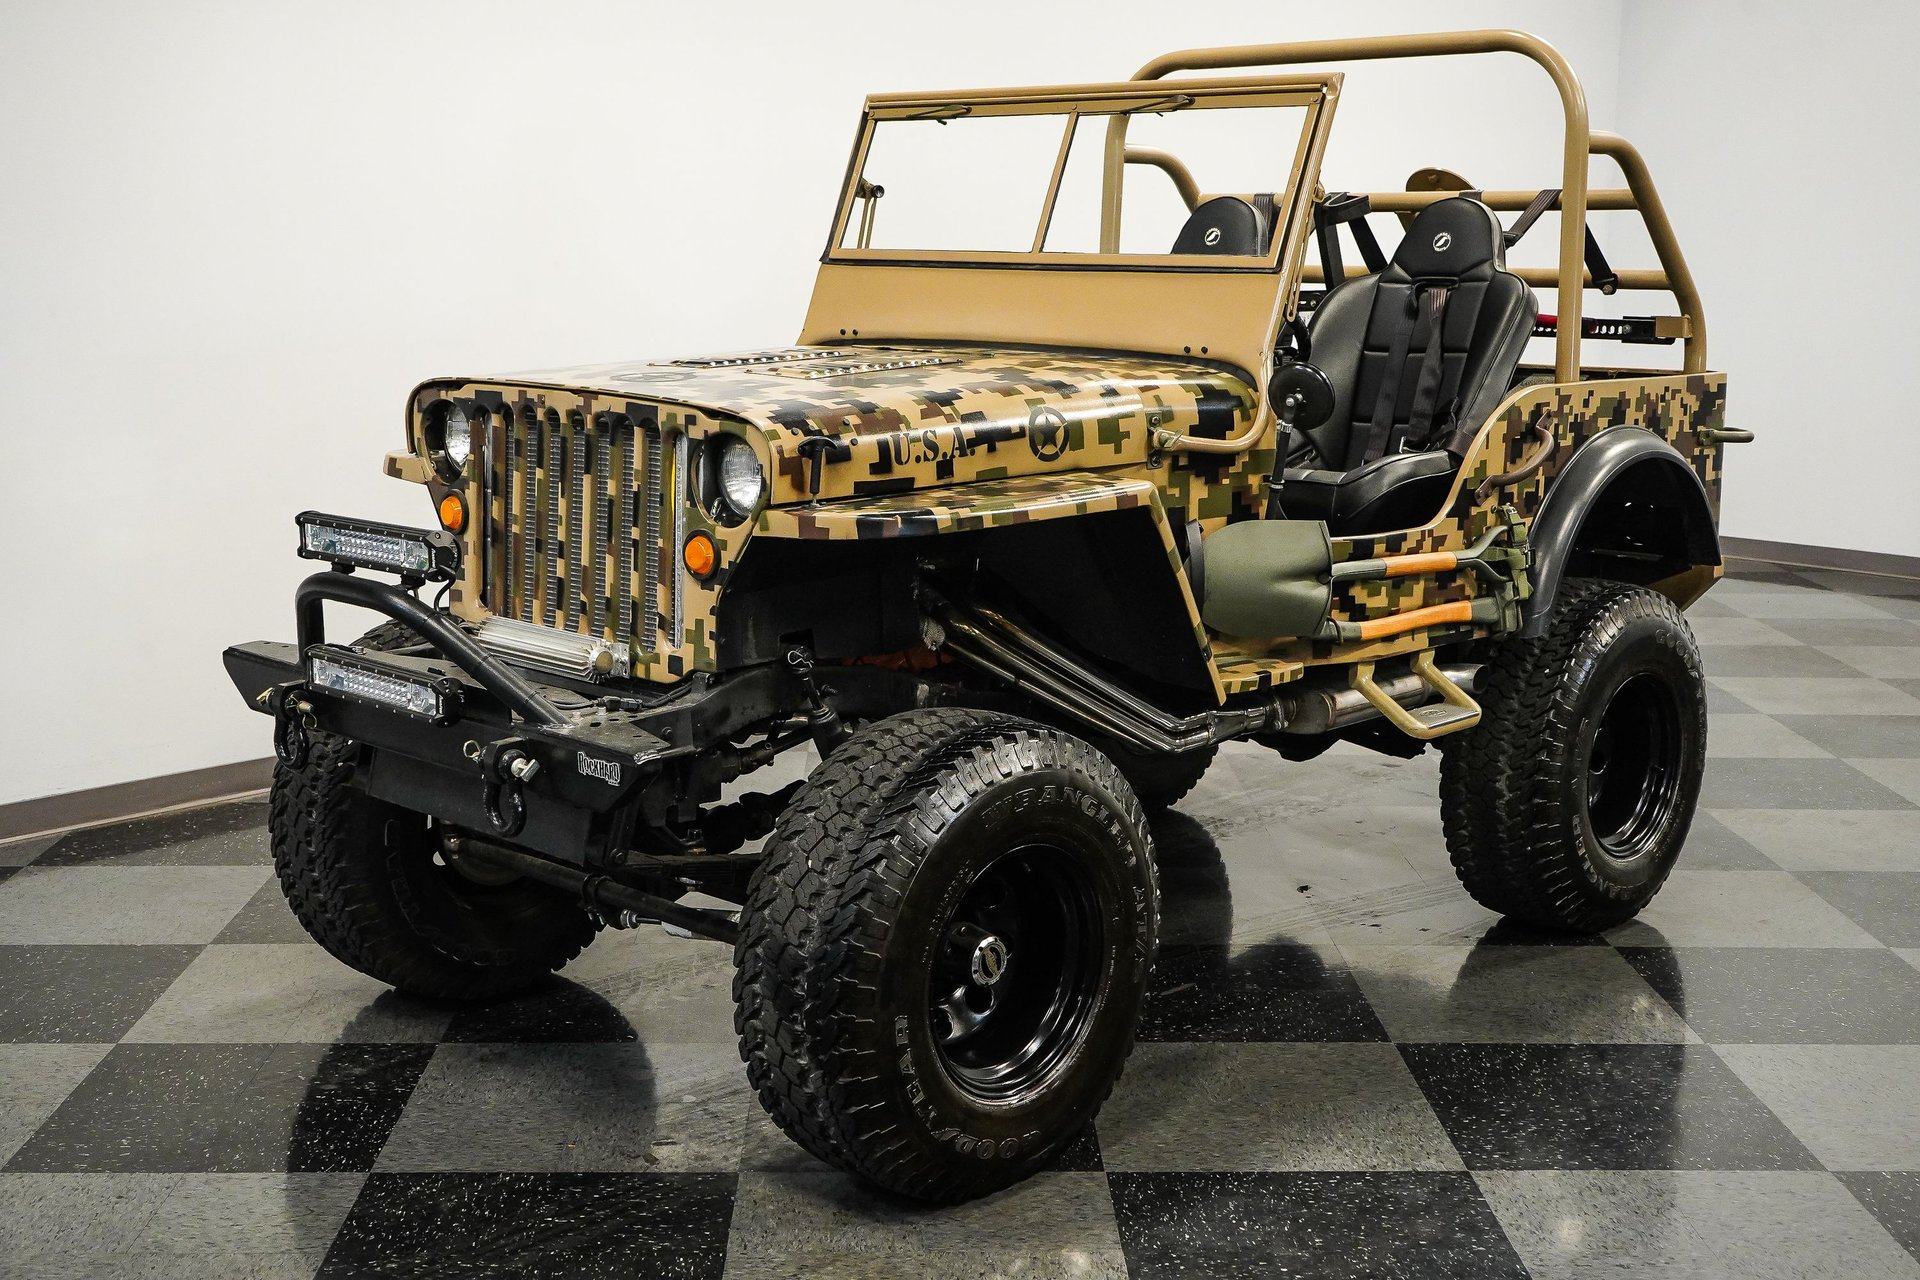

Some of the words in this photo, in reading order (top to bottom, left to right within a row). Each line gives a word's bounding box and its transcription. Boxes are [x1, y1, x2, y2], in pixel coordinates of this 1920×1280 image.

[890, 427, 976, 466] U.S.A.
[577, 751, 621, 783] ROCKHARD
[979, 785, 1137, 868] WRANGLER
